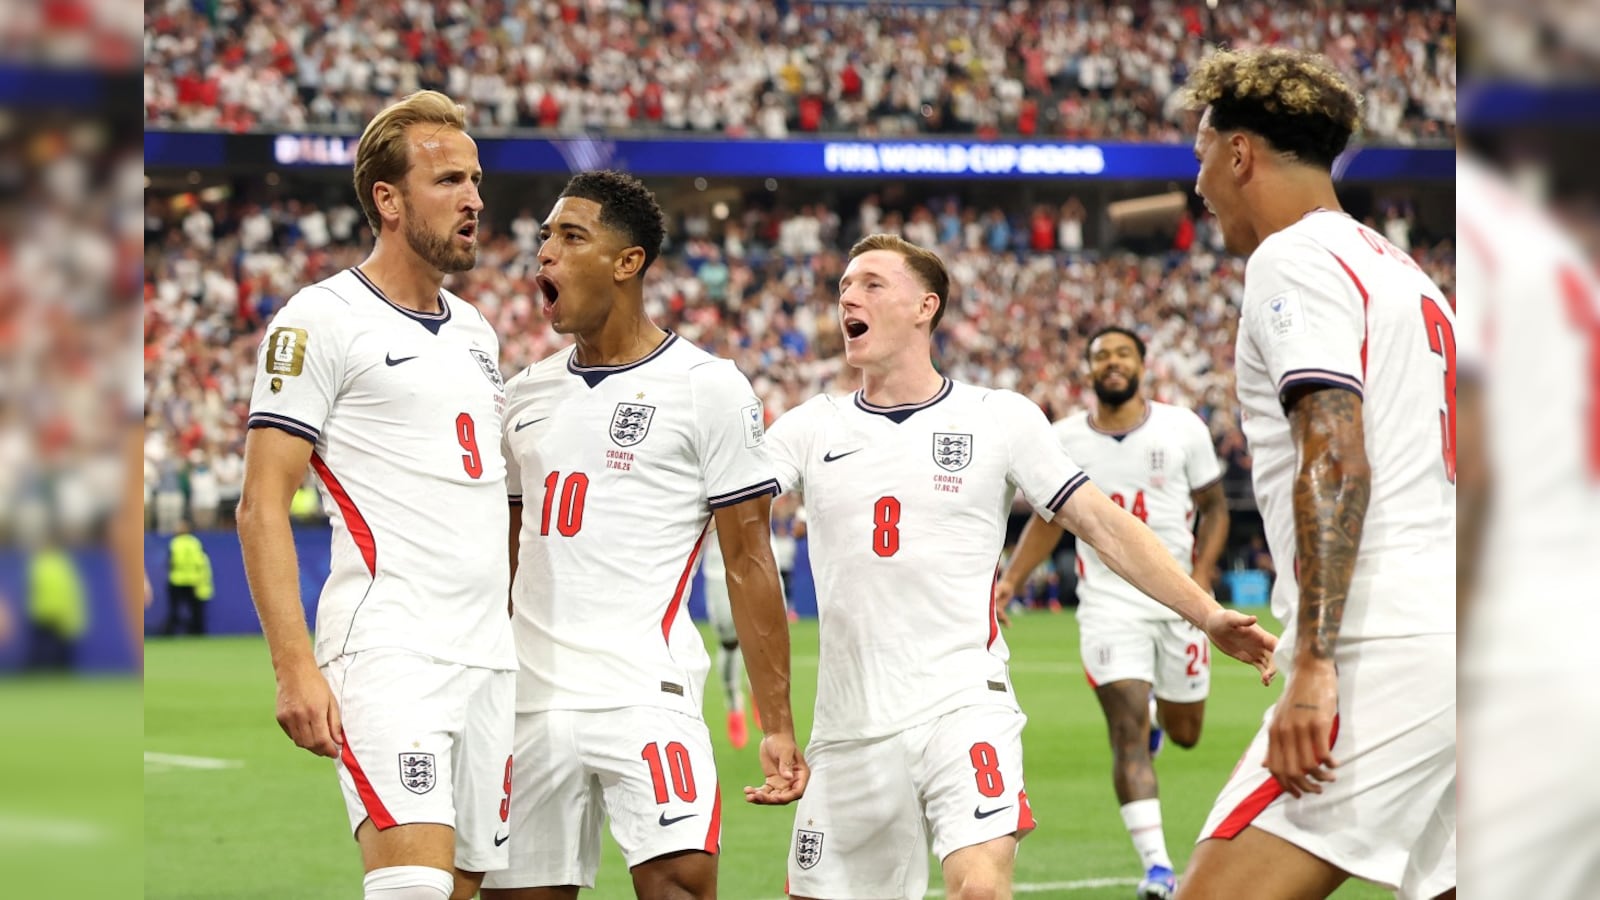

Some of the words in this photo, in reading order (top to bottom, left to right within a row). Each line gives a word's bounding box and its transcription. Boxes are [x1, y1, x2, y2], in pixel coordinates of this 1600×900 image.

[880, 144, 967, 173] WORLD
[968, 144, 1018, 173] CUP
[455, 412, 483, 479] 9
[606, 450, 634, 461] CROATIA
[540, 470, 590, 538] 10
[933, 474, 962, 485] CROATIA
[872, 496, 901, 557] 8
[499, 755, 513, 823] 9
[641, 741, 698, 805] 10
[968, 741, 1005, 798] 8
